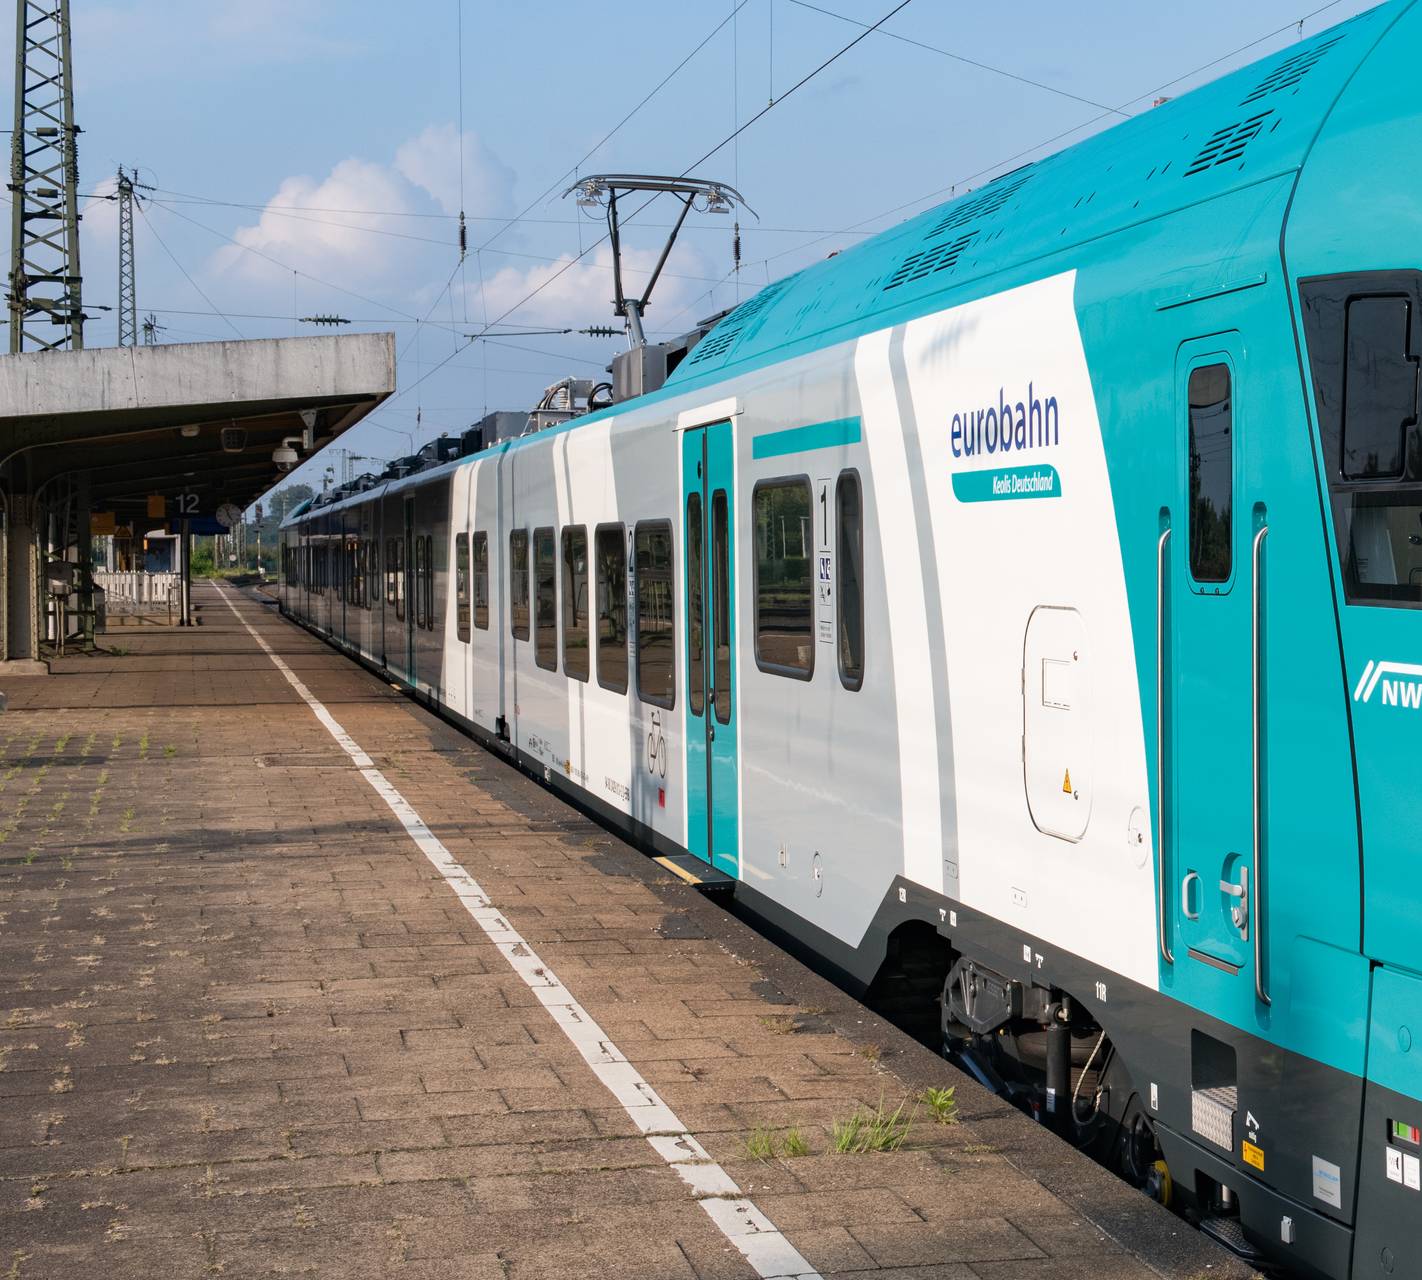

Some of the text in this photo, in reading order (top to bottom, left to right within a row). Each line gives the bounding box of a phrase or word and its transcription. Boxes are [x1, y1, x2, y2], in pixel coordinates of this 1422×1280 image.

[951, 381, 1059, 458] eurobahn
[993, 471, 1053, 495] Keolis Deutschland
[175, 494, 200, 513] 12
